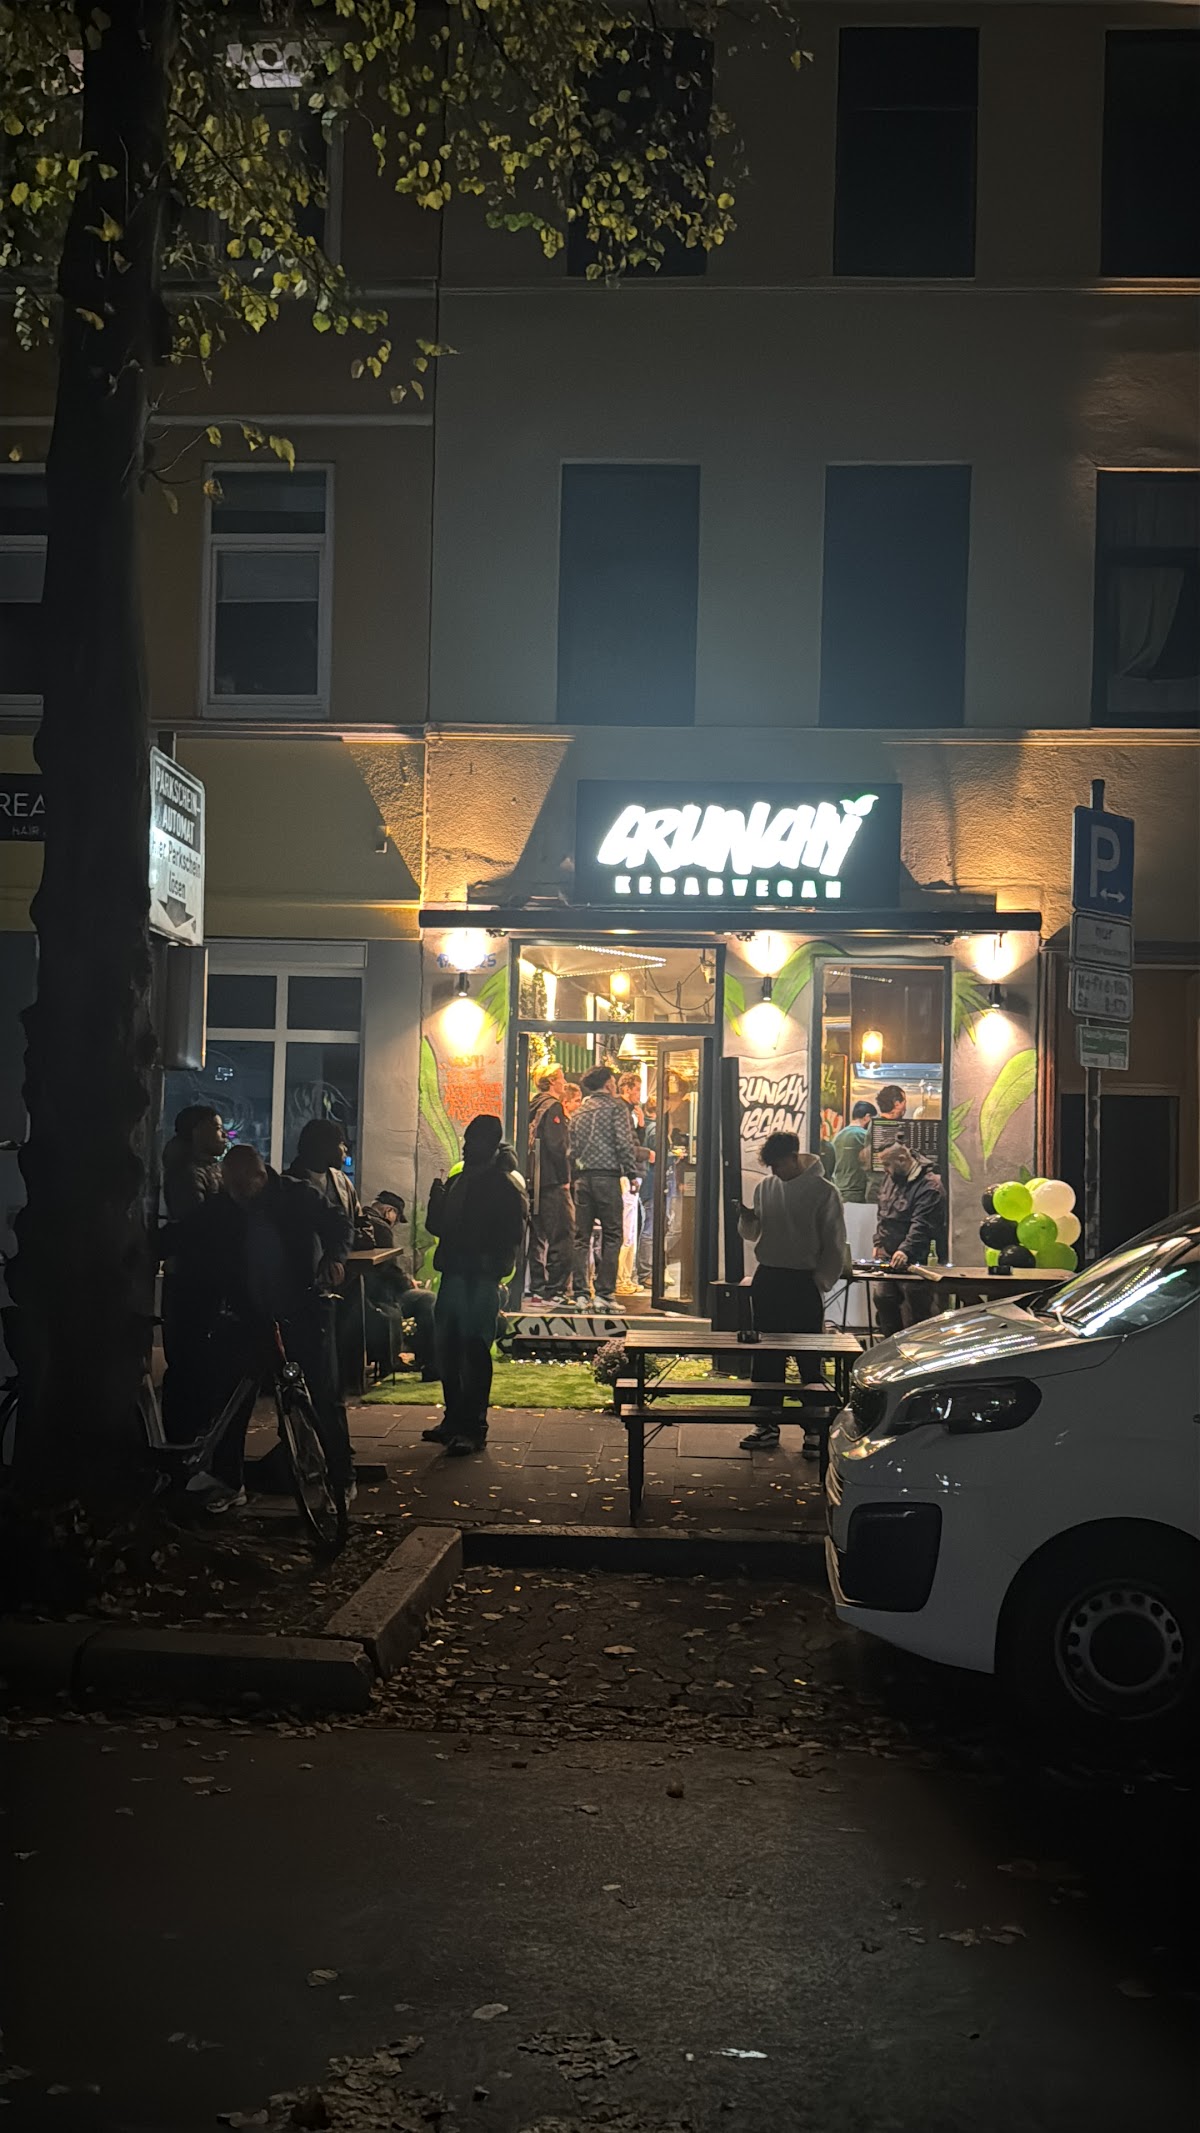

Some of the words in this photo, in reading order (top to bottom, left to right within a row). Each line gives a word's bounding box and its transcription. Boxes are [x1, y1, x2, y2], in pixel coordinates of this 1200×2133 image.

[155, 765, 201, 817] PARKSCHEIN-
[162, 803, 195, 845] AUTOMAT
[168, 840, 201, 879] Parkschein
[1089, 824, 1121, 897] P
[614, 876, 724, 896] KEBAB
[731, 878, 841, 898] VEGAN
[739, 1073, 808, 1111] RUNCHY
